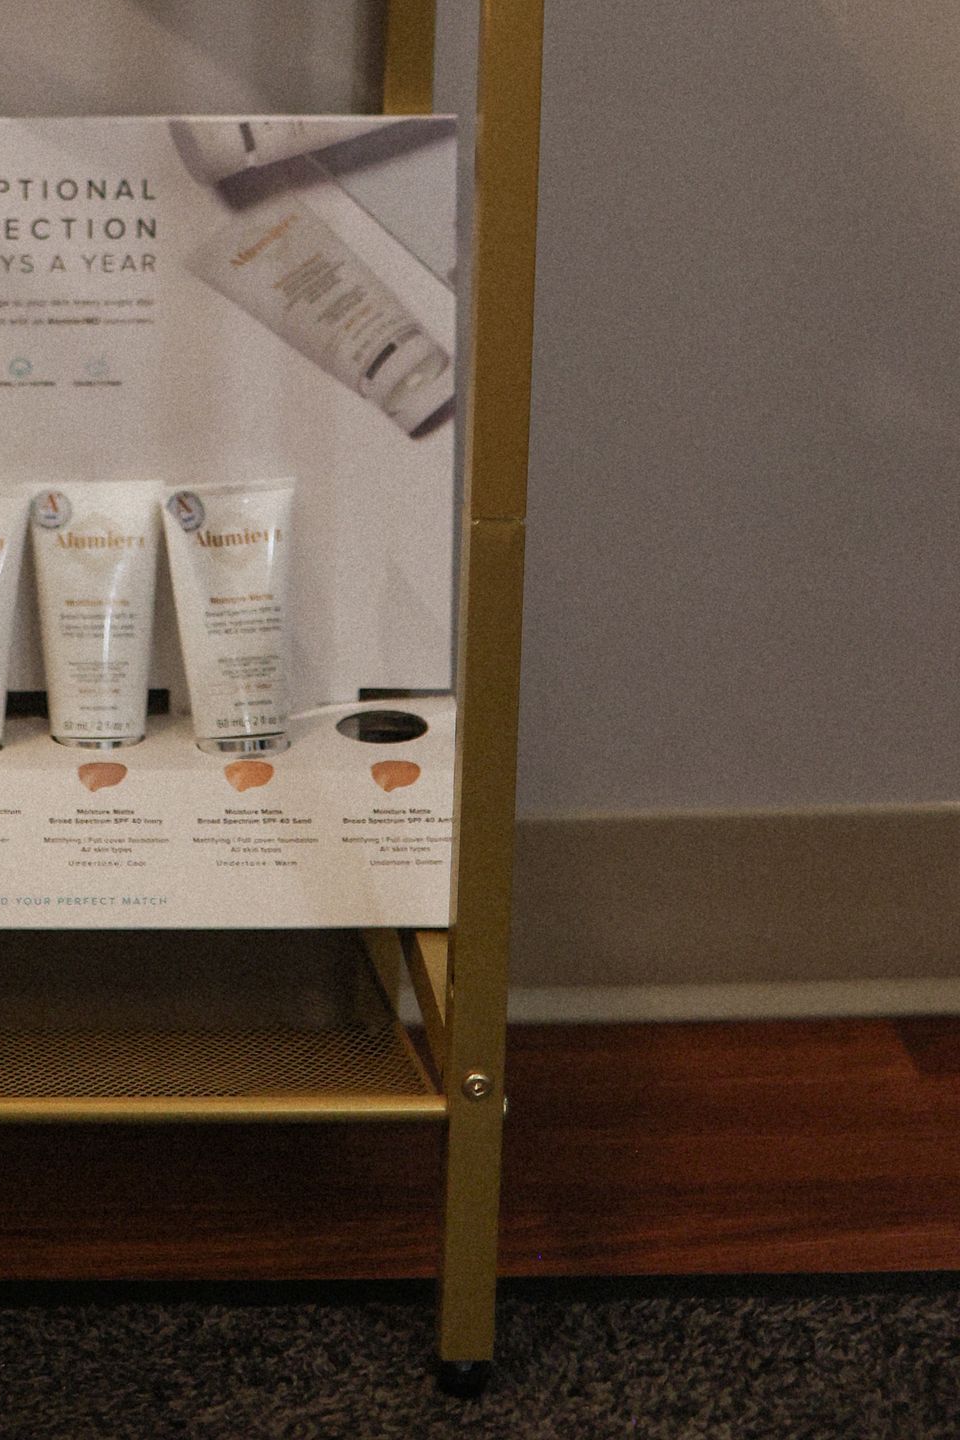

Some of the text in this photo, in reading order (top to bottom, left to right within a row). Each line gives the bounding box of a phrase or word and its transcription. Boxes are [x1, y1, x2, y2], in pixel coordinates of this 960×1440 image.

[50, 253, 67, 274] A
[82, 253, 157, 274] YEAR
[16, 897, 50, 905] YOUR
[57, 897, 115, 905] PERFECT
[122, 897, 167, 905] MATCH
